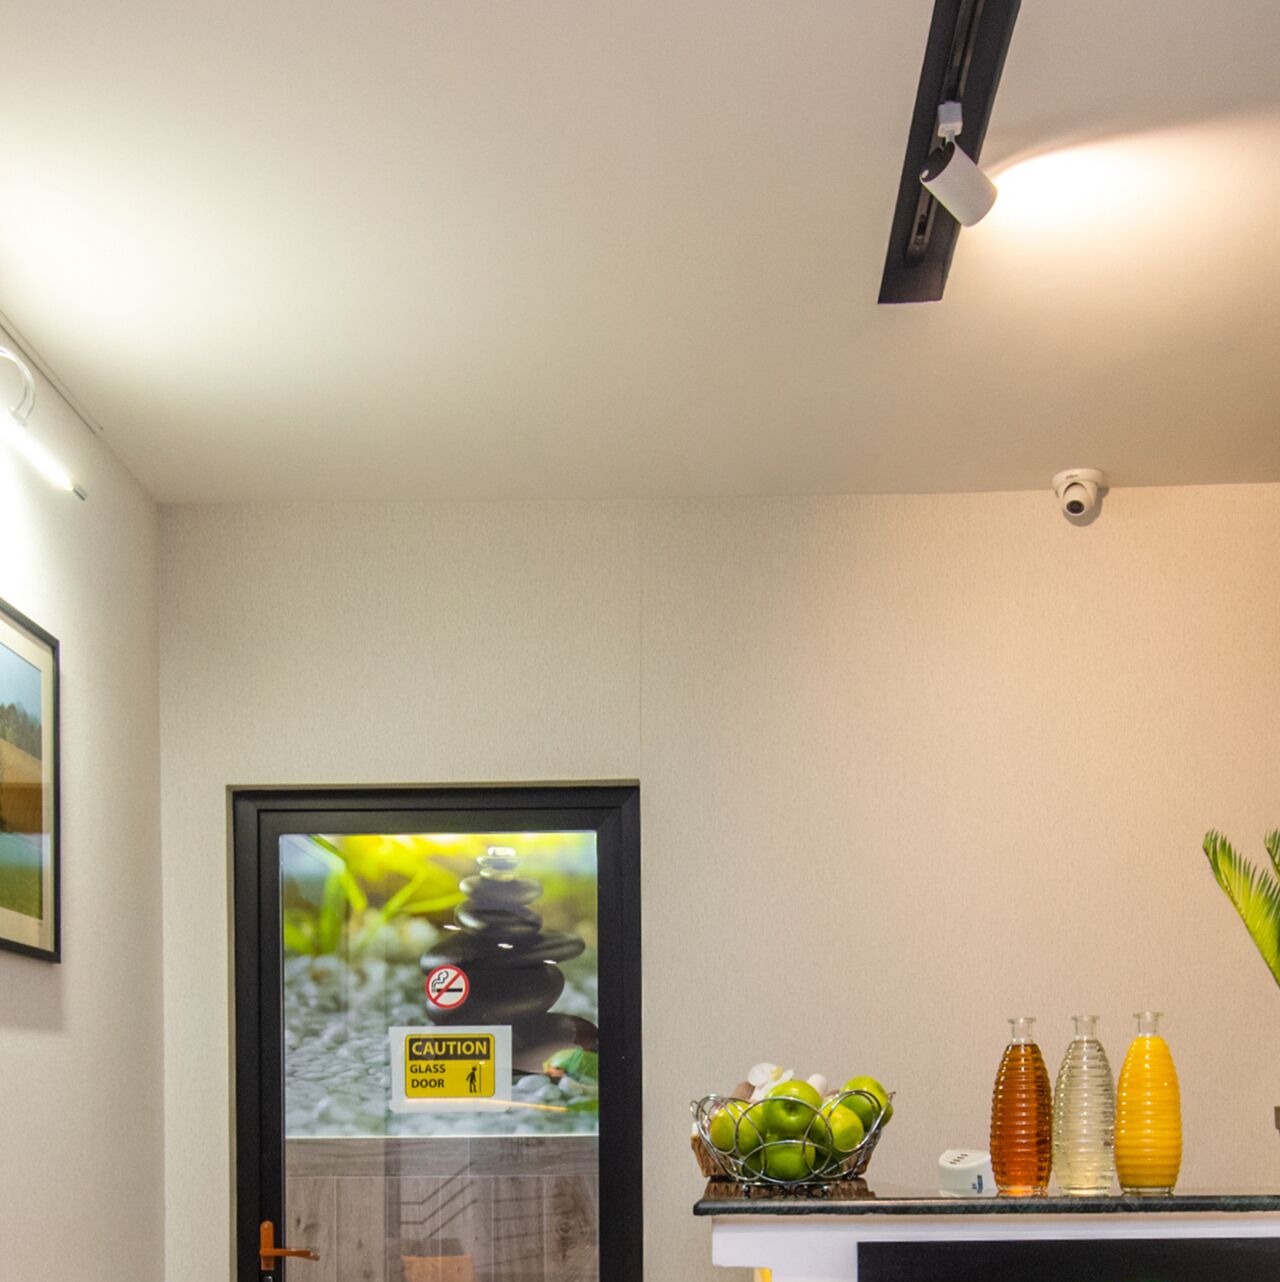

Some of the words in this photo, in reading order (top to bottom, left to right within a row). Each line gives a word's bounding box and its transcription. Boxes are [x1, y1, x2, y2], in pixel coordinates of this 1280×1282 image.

[411, 1041, 487, 1056] CAUTION
[409, 1064, 446, 1074] GLASS
[411, 1078, 445, 1088] DOOR
